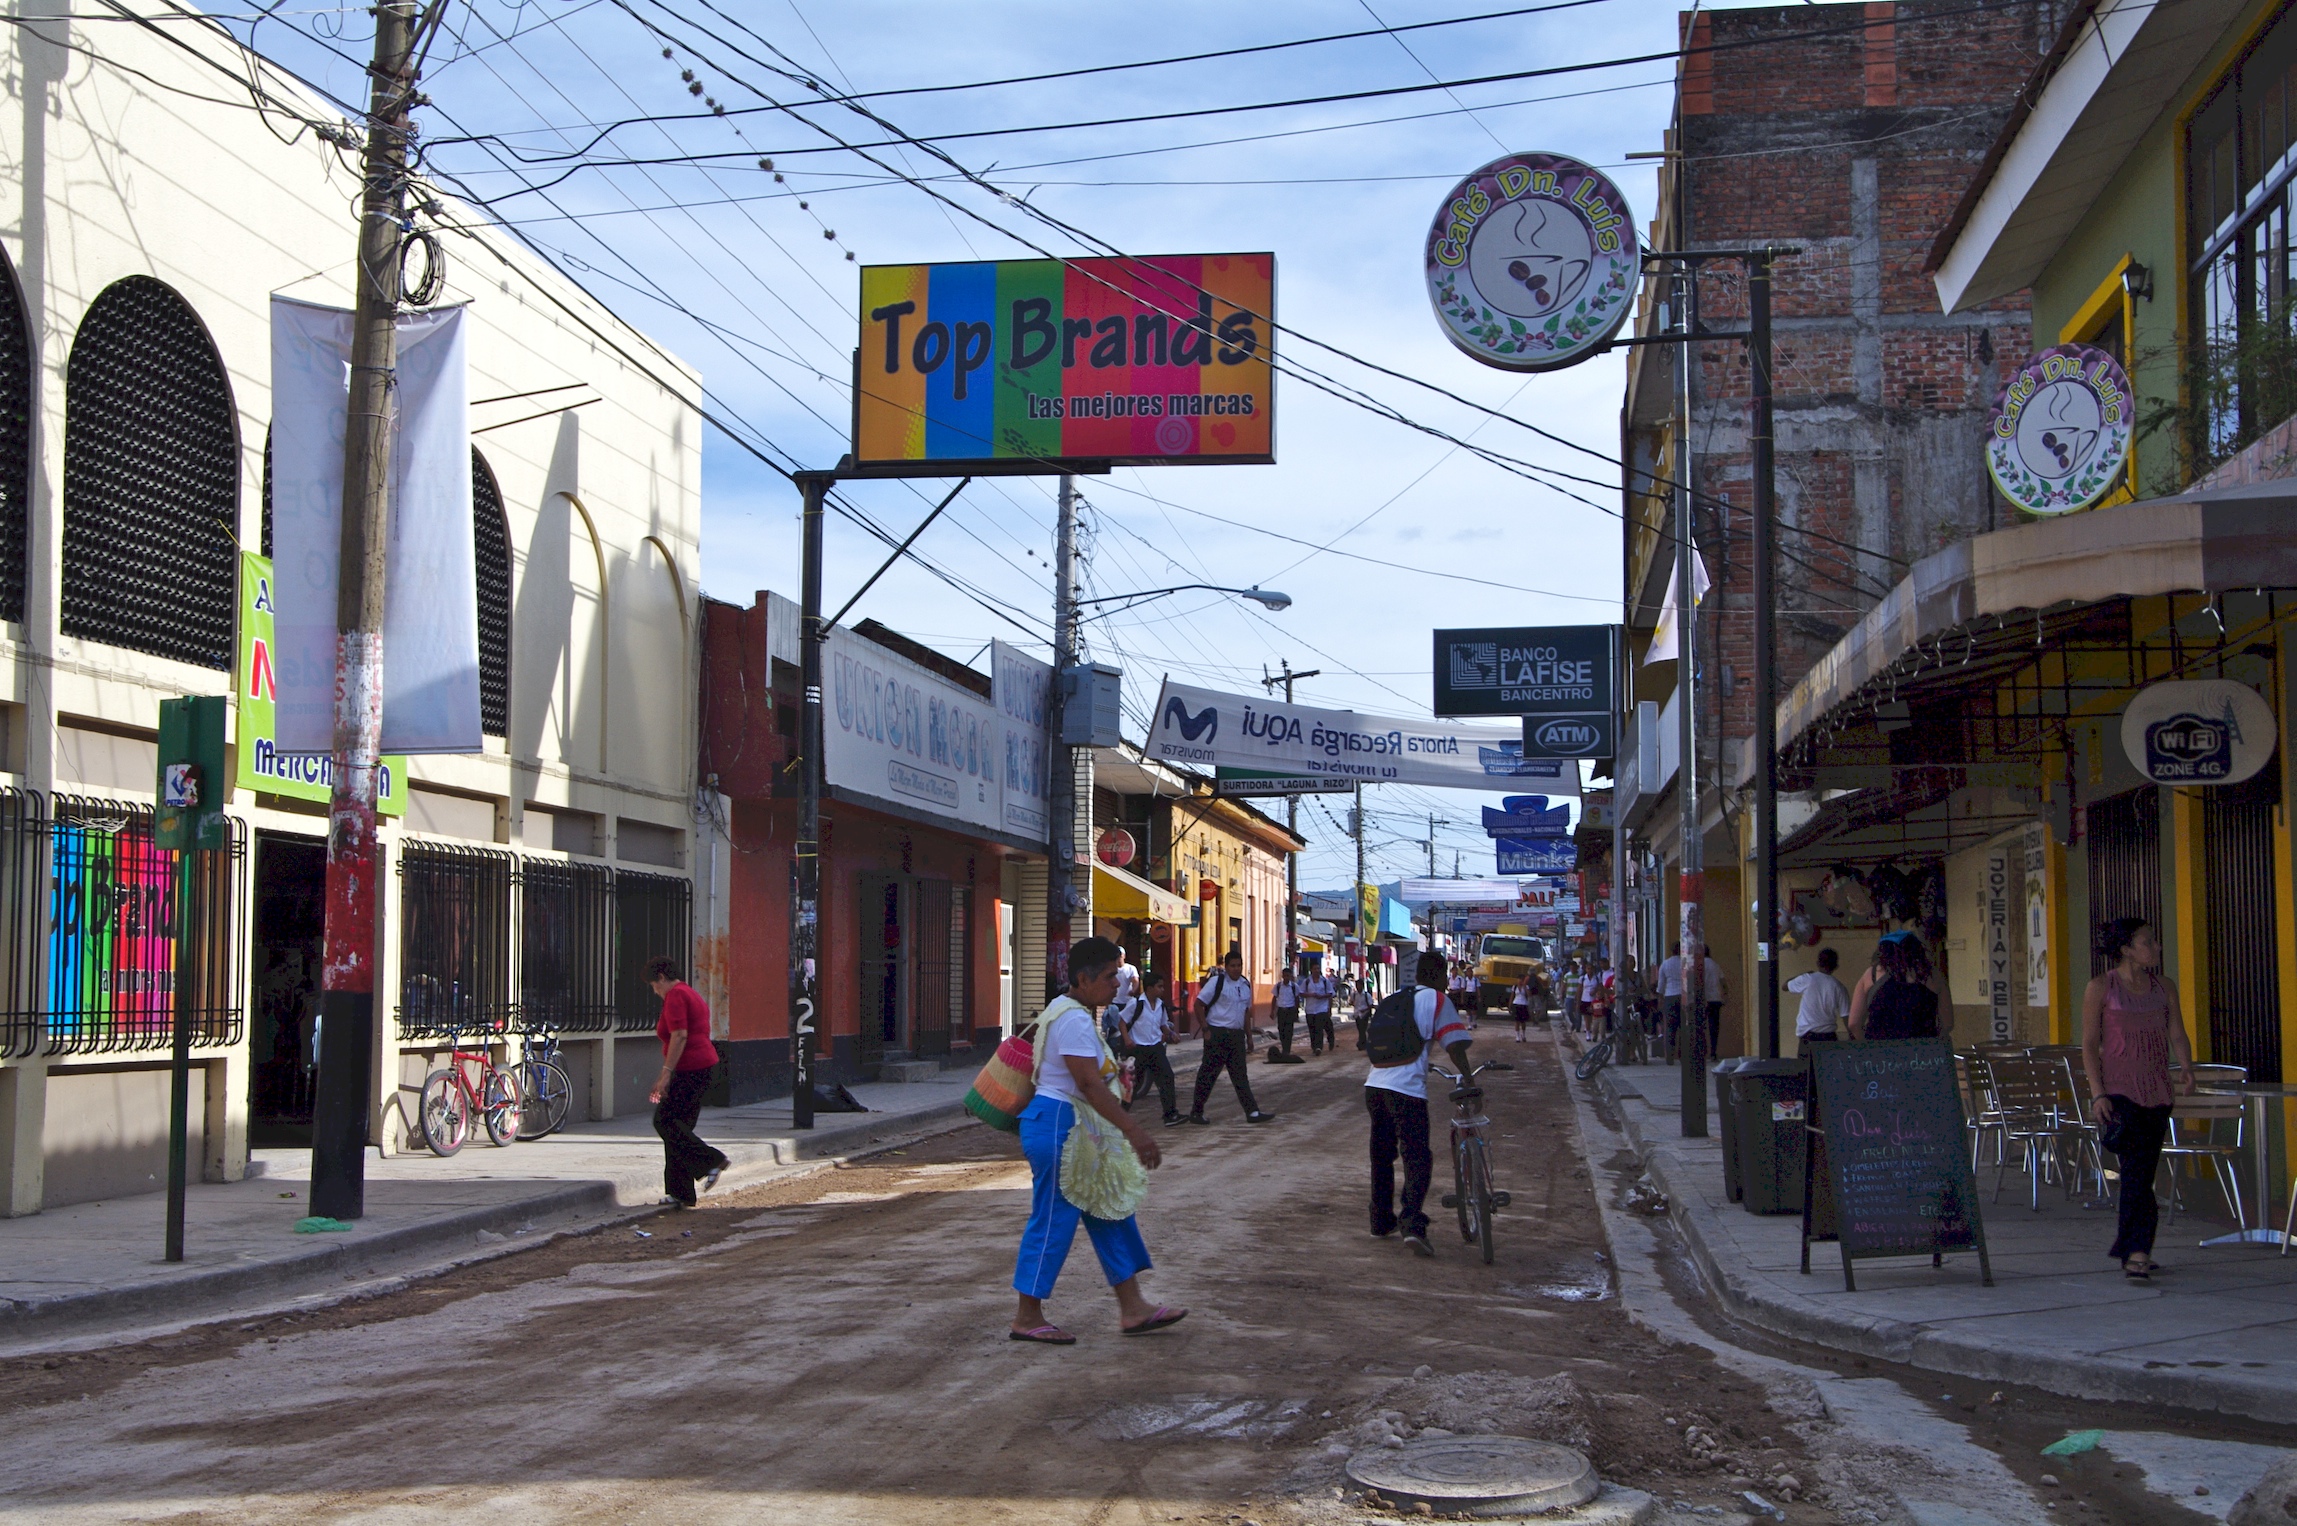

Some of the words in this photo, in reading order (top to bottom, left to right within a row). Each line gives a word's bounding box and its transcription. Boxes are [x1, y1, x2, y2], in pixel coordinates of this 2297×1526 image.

[1436, 184, 1490, 267] Café
[1497, 165, 1563, 199] Dn.
[1572, 176, 1622, 253] Luis
[871, 300, 992, 400] Top
[1009, 293, 1258, 370] Brands
[1028, 393, 1064, 419] Las
[1070, 391, 1163, 421] mejores
[1168, 393, 1253, 417] marcas
[1995, 371, 2035, 438] Café
[2041, 355, 2086, 383] Dn.
[2090, 362, 2124, 424] Luis
[1500, 647, 1557, 662] BANCO
[1501, 661, 1593, 685] LAFISE
[1501, 688, 1593, 701] BANCENTRO
[835, 651, 921, 758] UNION
[929, 696, 994, 783] MODA
[1544, 727, 1590, 742] ATM
[2154, 763, 2195, 776] ZONE
[1223, 780, 1274, 790] SURTIDORA
[796, 998, 815, 1034] 2
